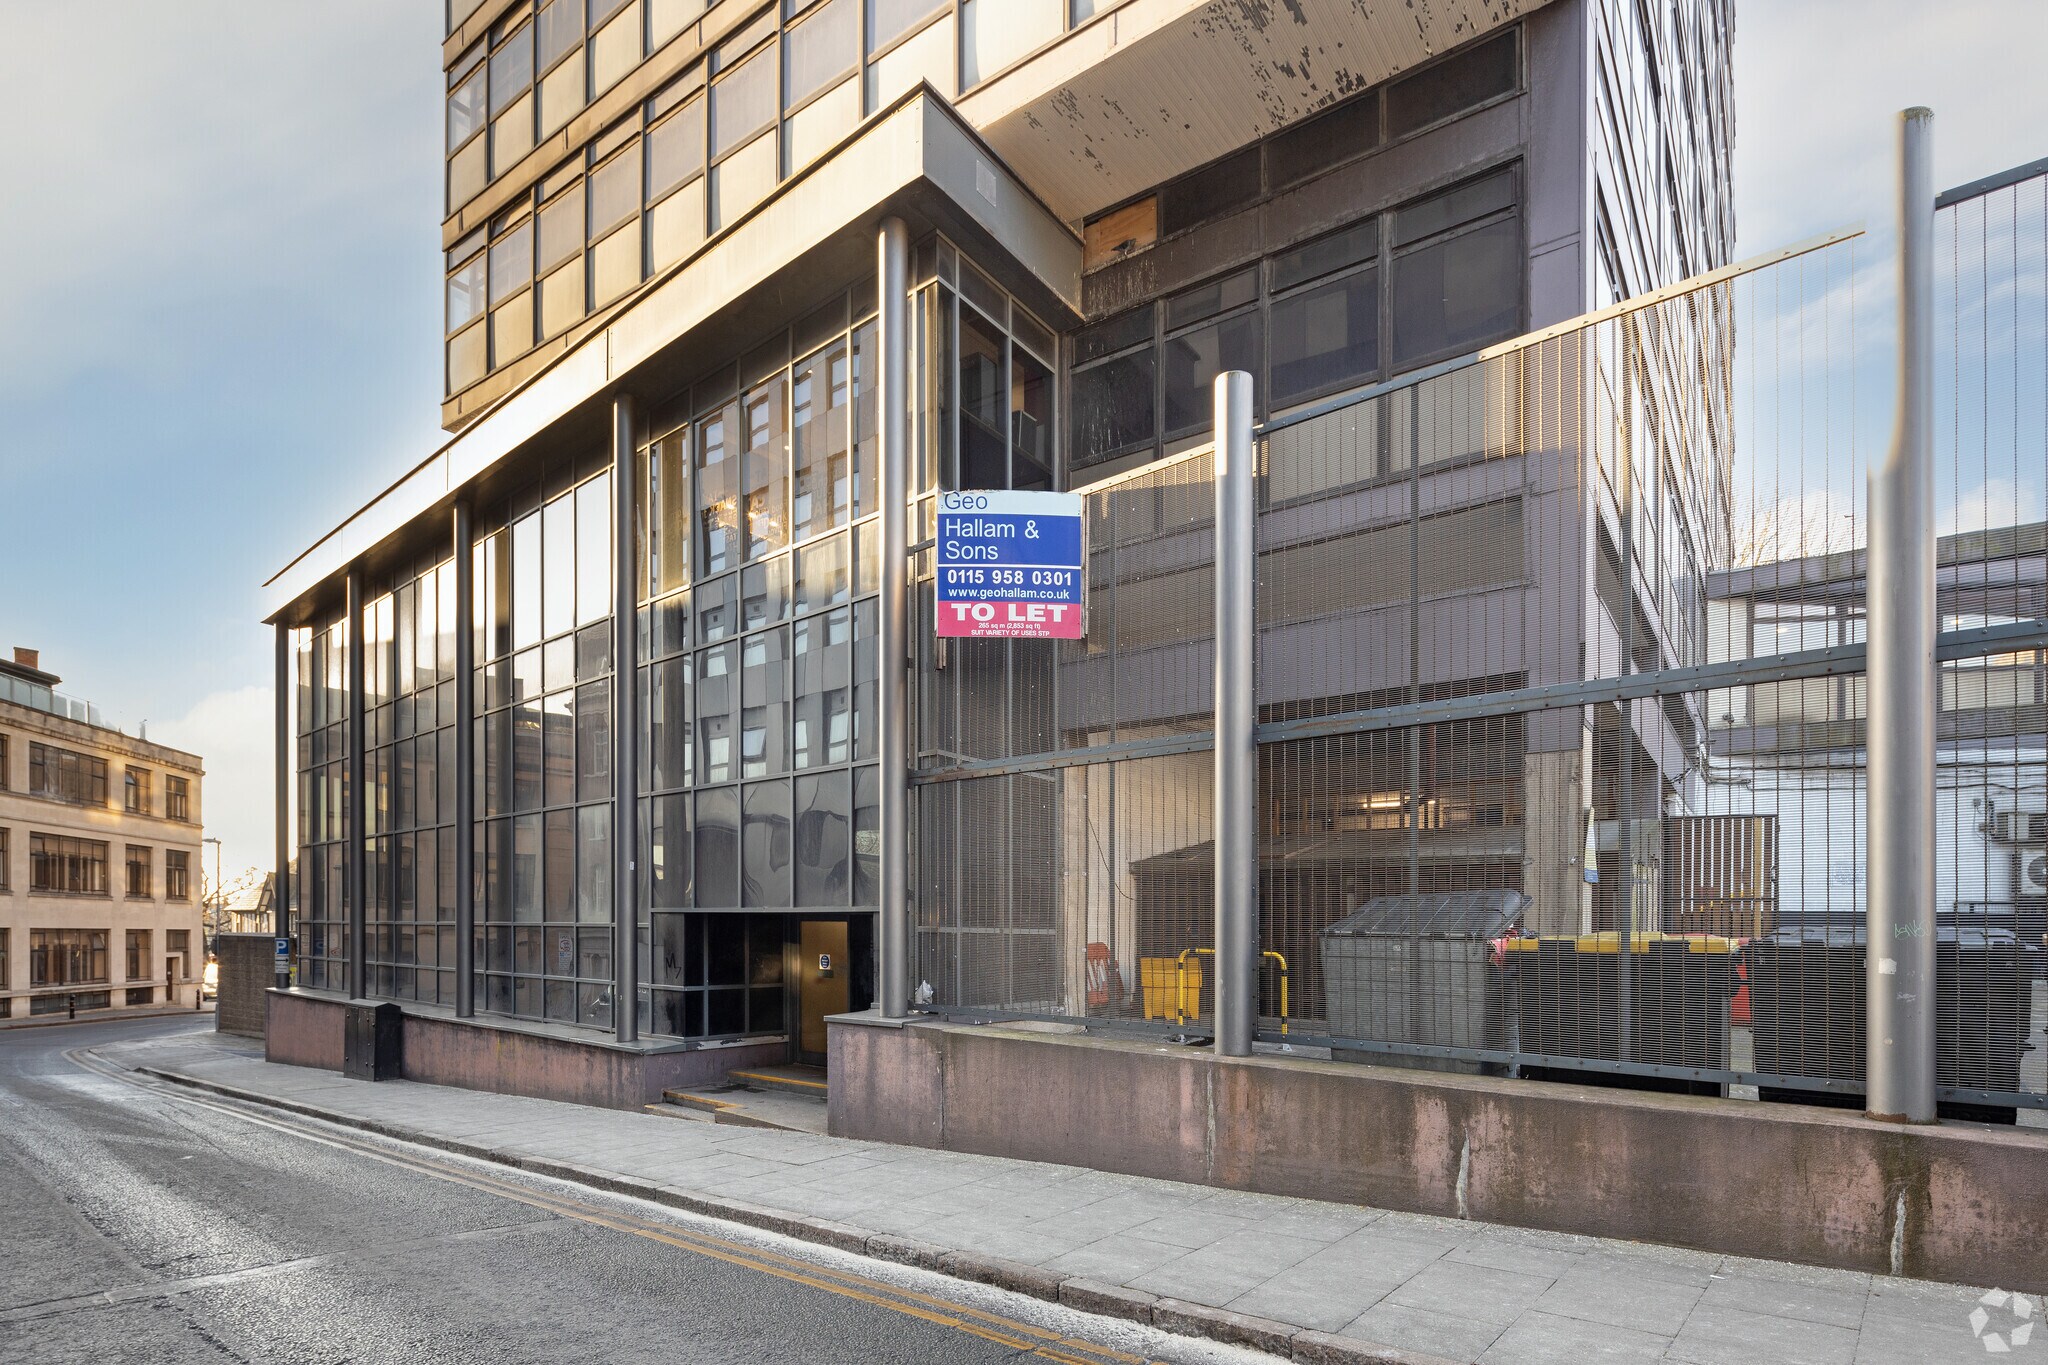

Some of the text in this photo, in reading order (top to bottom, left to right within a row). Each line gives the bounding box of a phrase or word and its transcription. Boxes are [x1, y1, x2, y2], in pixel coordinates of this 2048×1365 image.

[944, 492, 988, 510] Geo
[945, 518, 1040, 539] Hallam &
[945, 540, 999, 560] Sons
[947, 569, 1072, 586] 0115 958 0301
[948, 588, 1070, 600] www.geohallam.co.uk
[950, 603, 1068, 623] TO LET
[1021, 629, 1037, 637] USES
[276, 940, 287, 954] P
